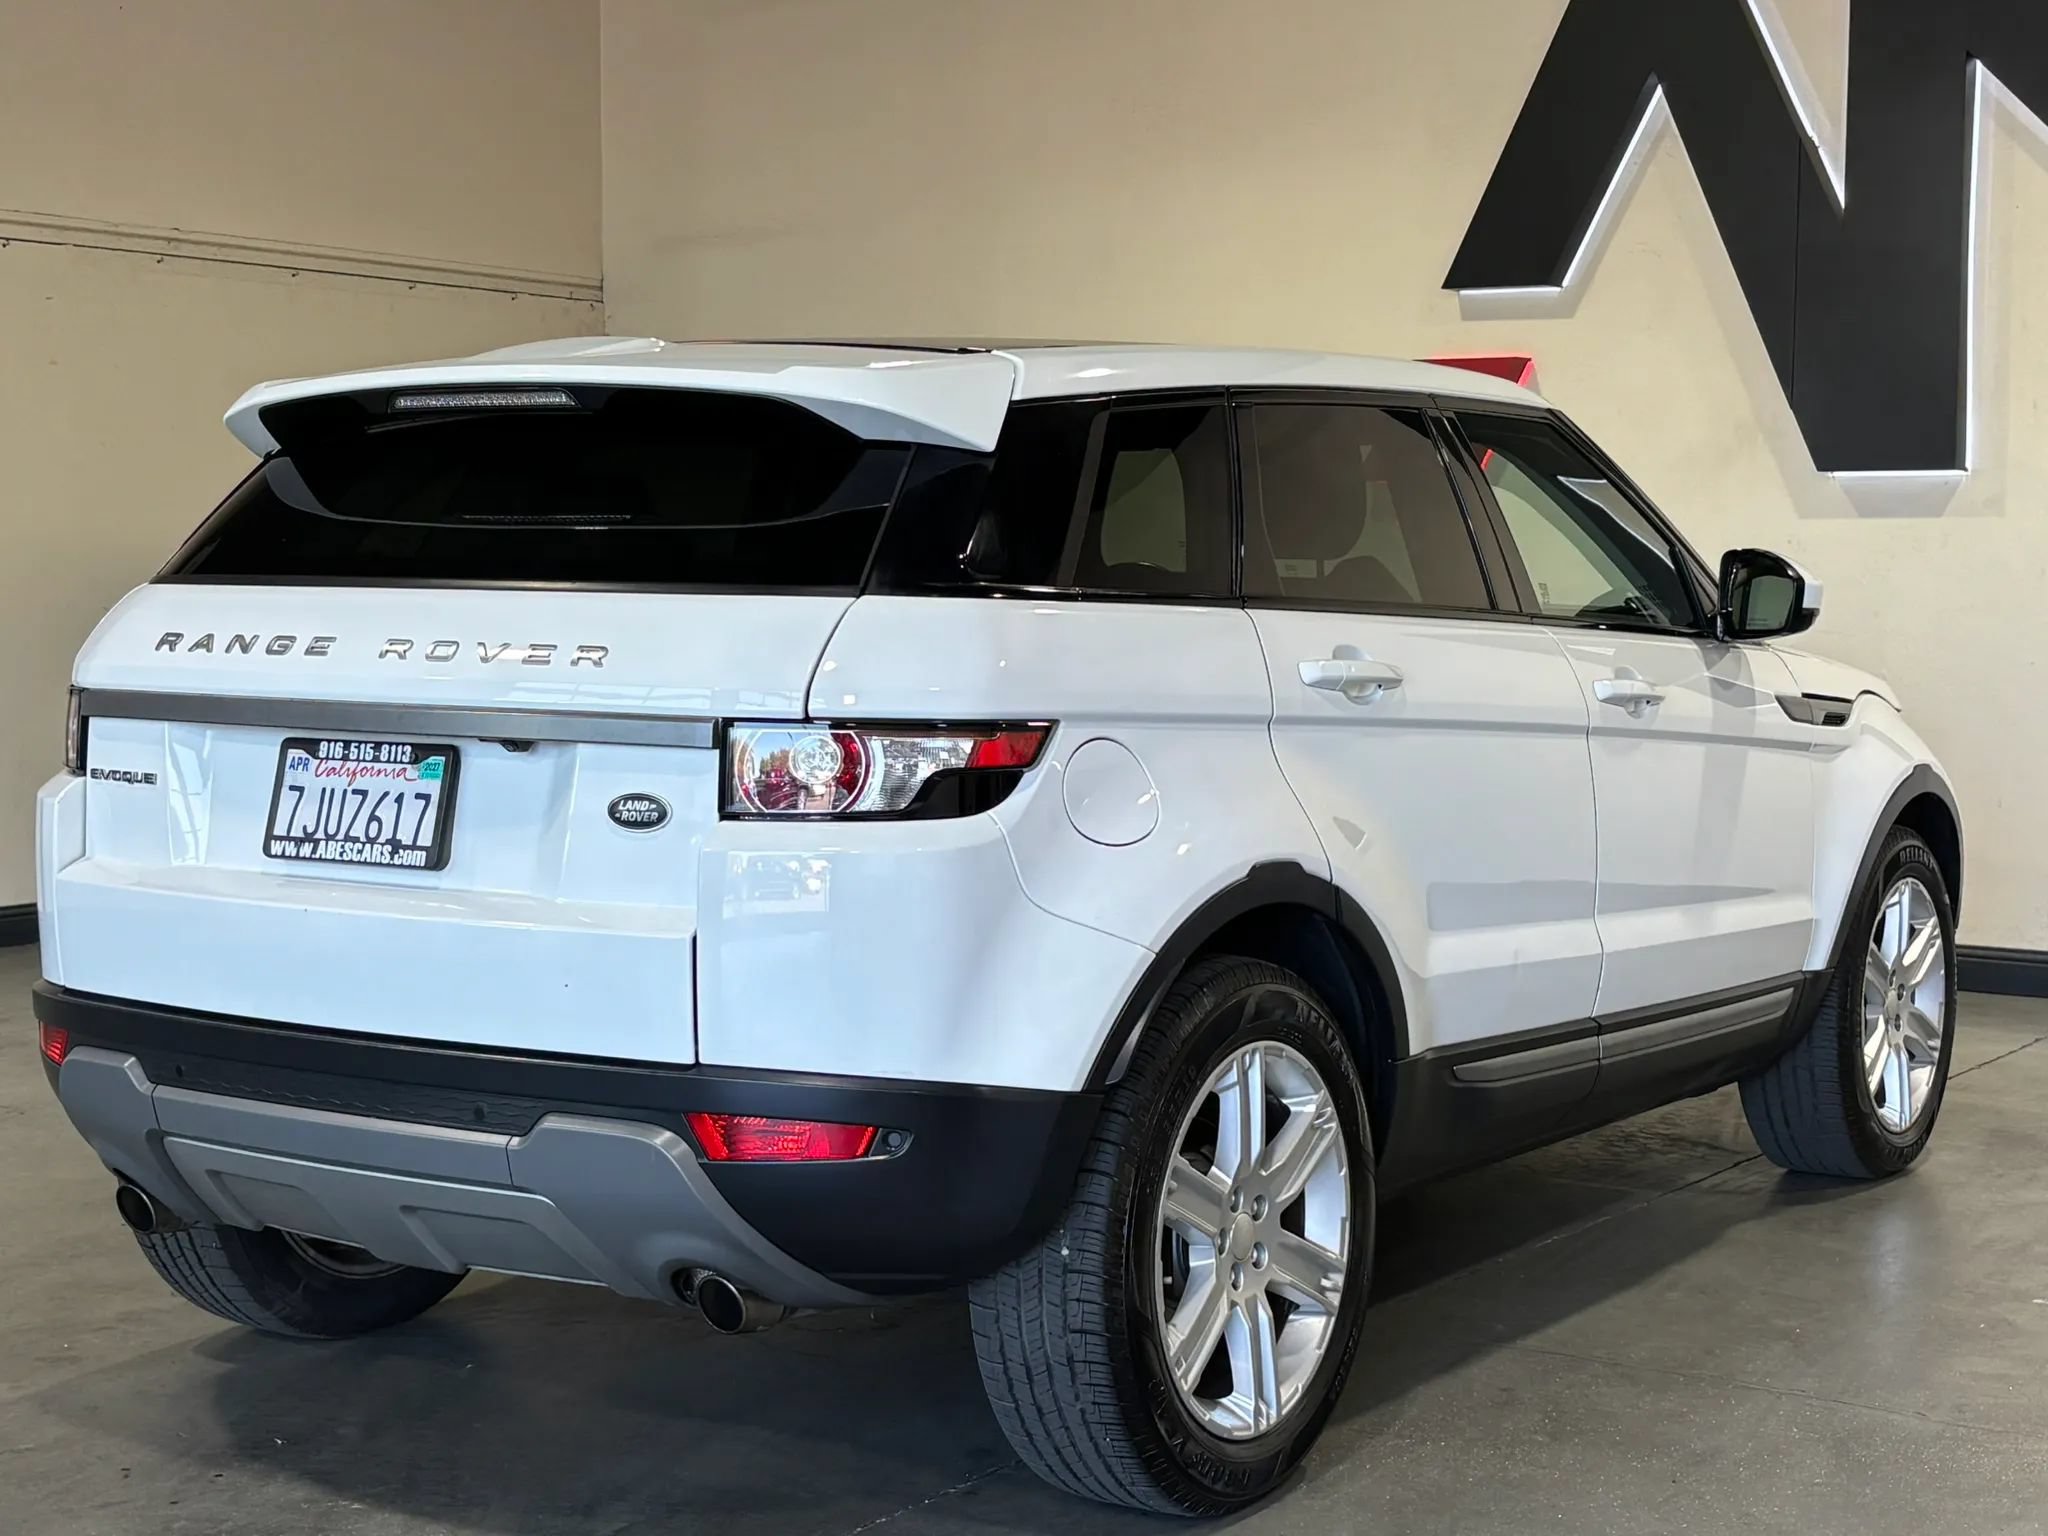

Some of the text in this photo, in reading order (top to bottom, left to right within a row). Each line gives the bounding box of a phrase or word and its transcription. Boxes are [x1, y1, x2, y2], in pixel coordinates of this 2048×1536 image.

[155, 631, 610, 667] RANGE ROVER
[318, 741, 413, 762] 916-515-8113
[288, 756, 309, 772] APR
[314, 760, 418, 787] California
[90, 768, 157, 785] EVOQUE
[618, 800, 649, 811] LAND
[285, 785, 432, 847] 7JUZ617
[621, 811, 659, 822] ROVER
